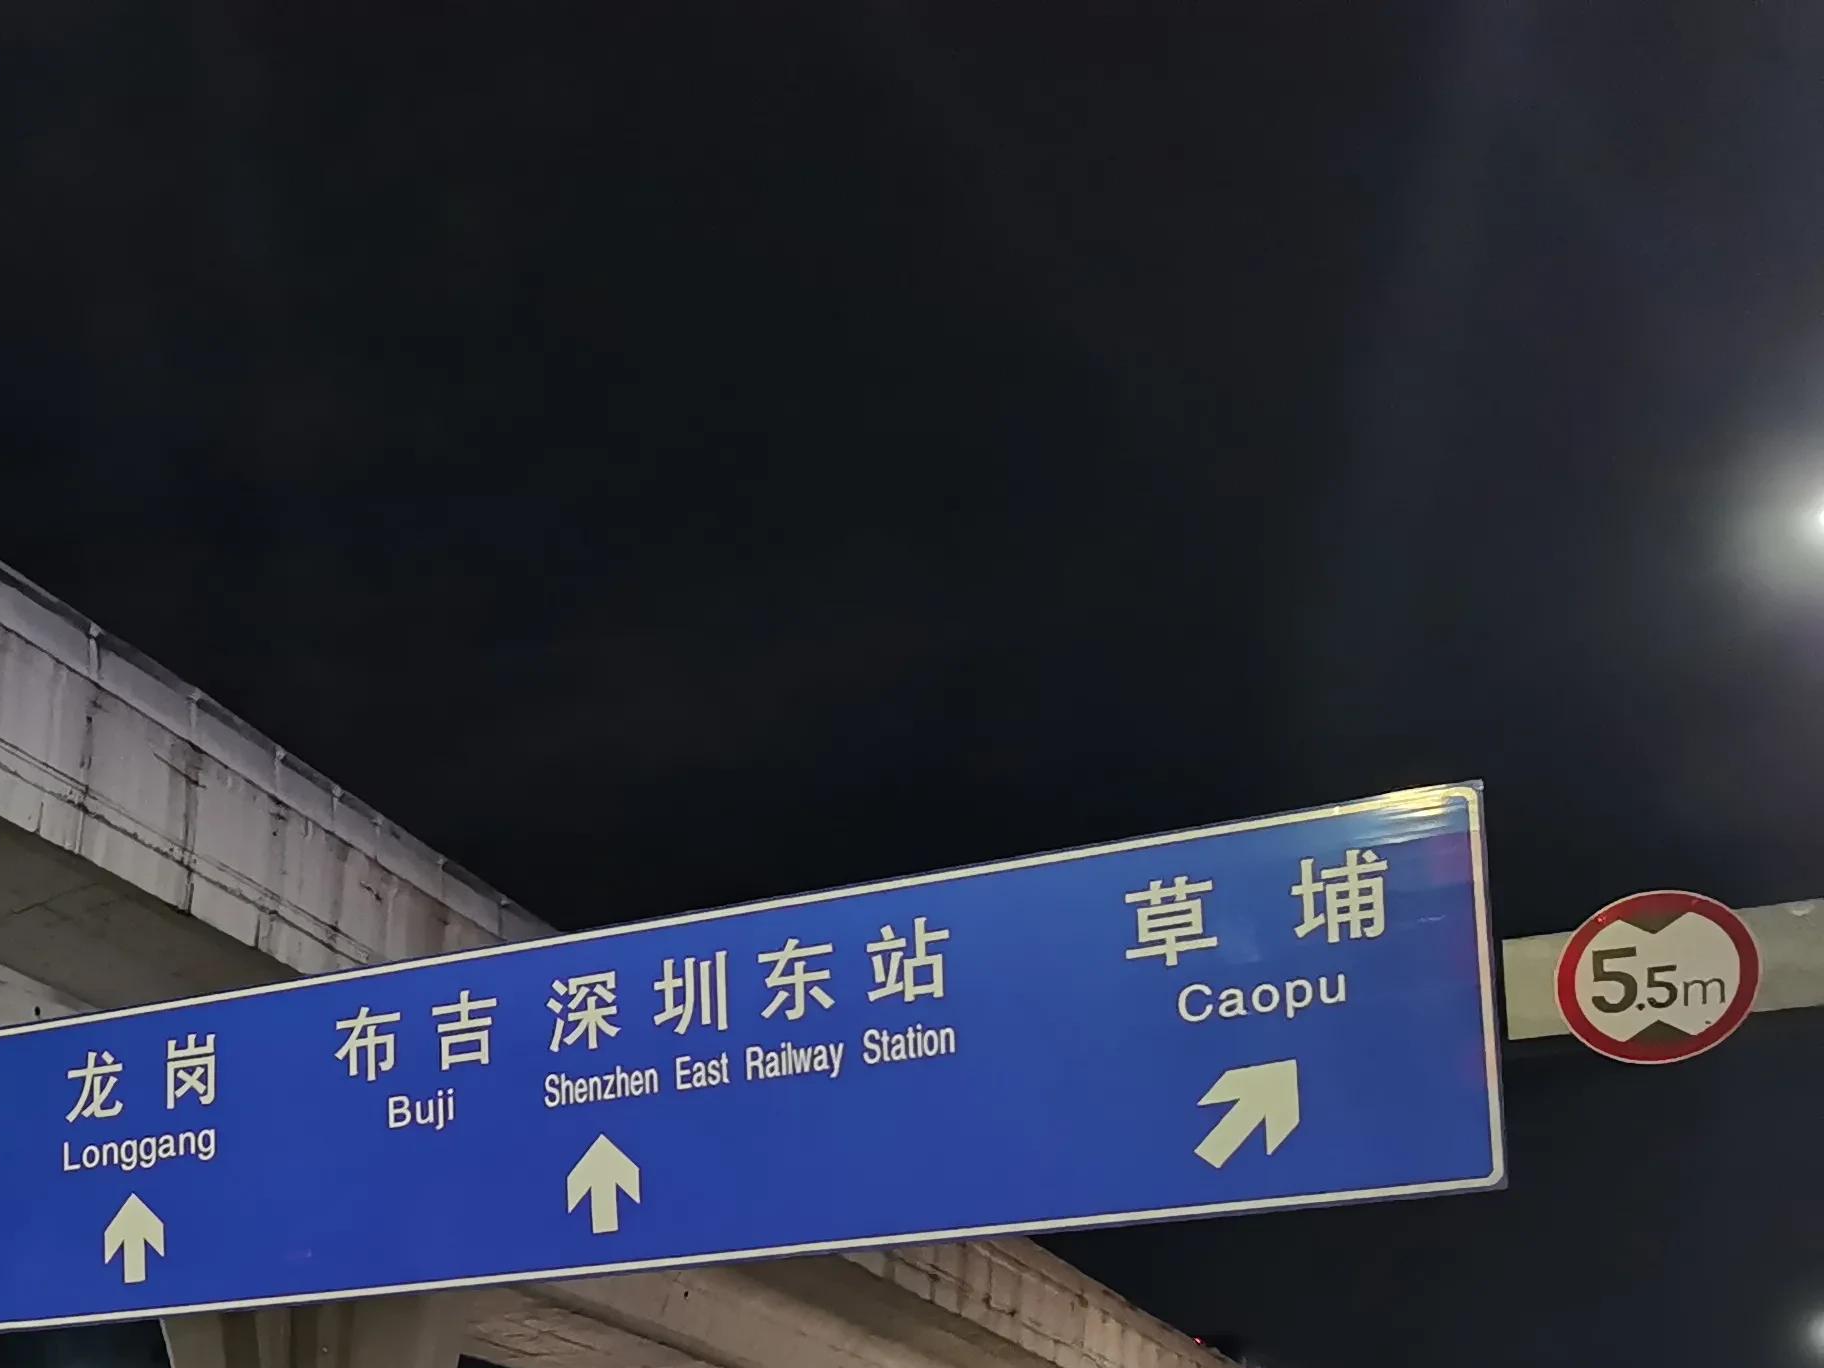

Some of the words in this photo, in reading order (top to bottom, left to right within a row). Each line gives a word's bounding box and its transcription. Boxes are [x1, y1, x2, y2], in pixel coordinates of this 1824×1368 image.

[1123, 848, 1390, 967] 草埔
[546, 916, 952, 1054] 深圳东站
[1176, 972, 1347, 1022] Caopu
[1589, 946, 1726, 1013] 5.5m
[64, 1033, 217, 1123] 龙岗
[334, 989, 498, 1083] 布吉
[543, 1065, 660, 1109] Shenzhen
[675, 1051, 731, 1091] East
[745, 1040, 845, 1081] Railway
[862, 1022, 957, 1066] Station
[63, 1124, 217, 1173] Longgang
[387, 1087, 455, 1131] Buji
